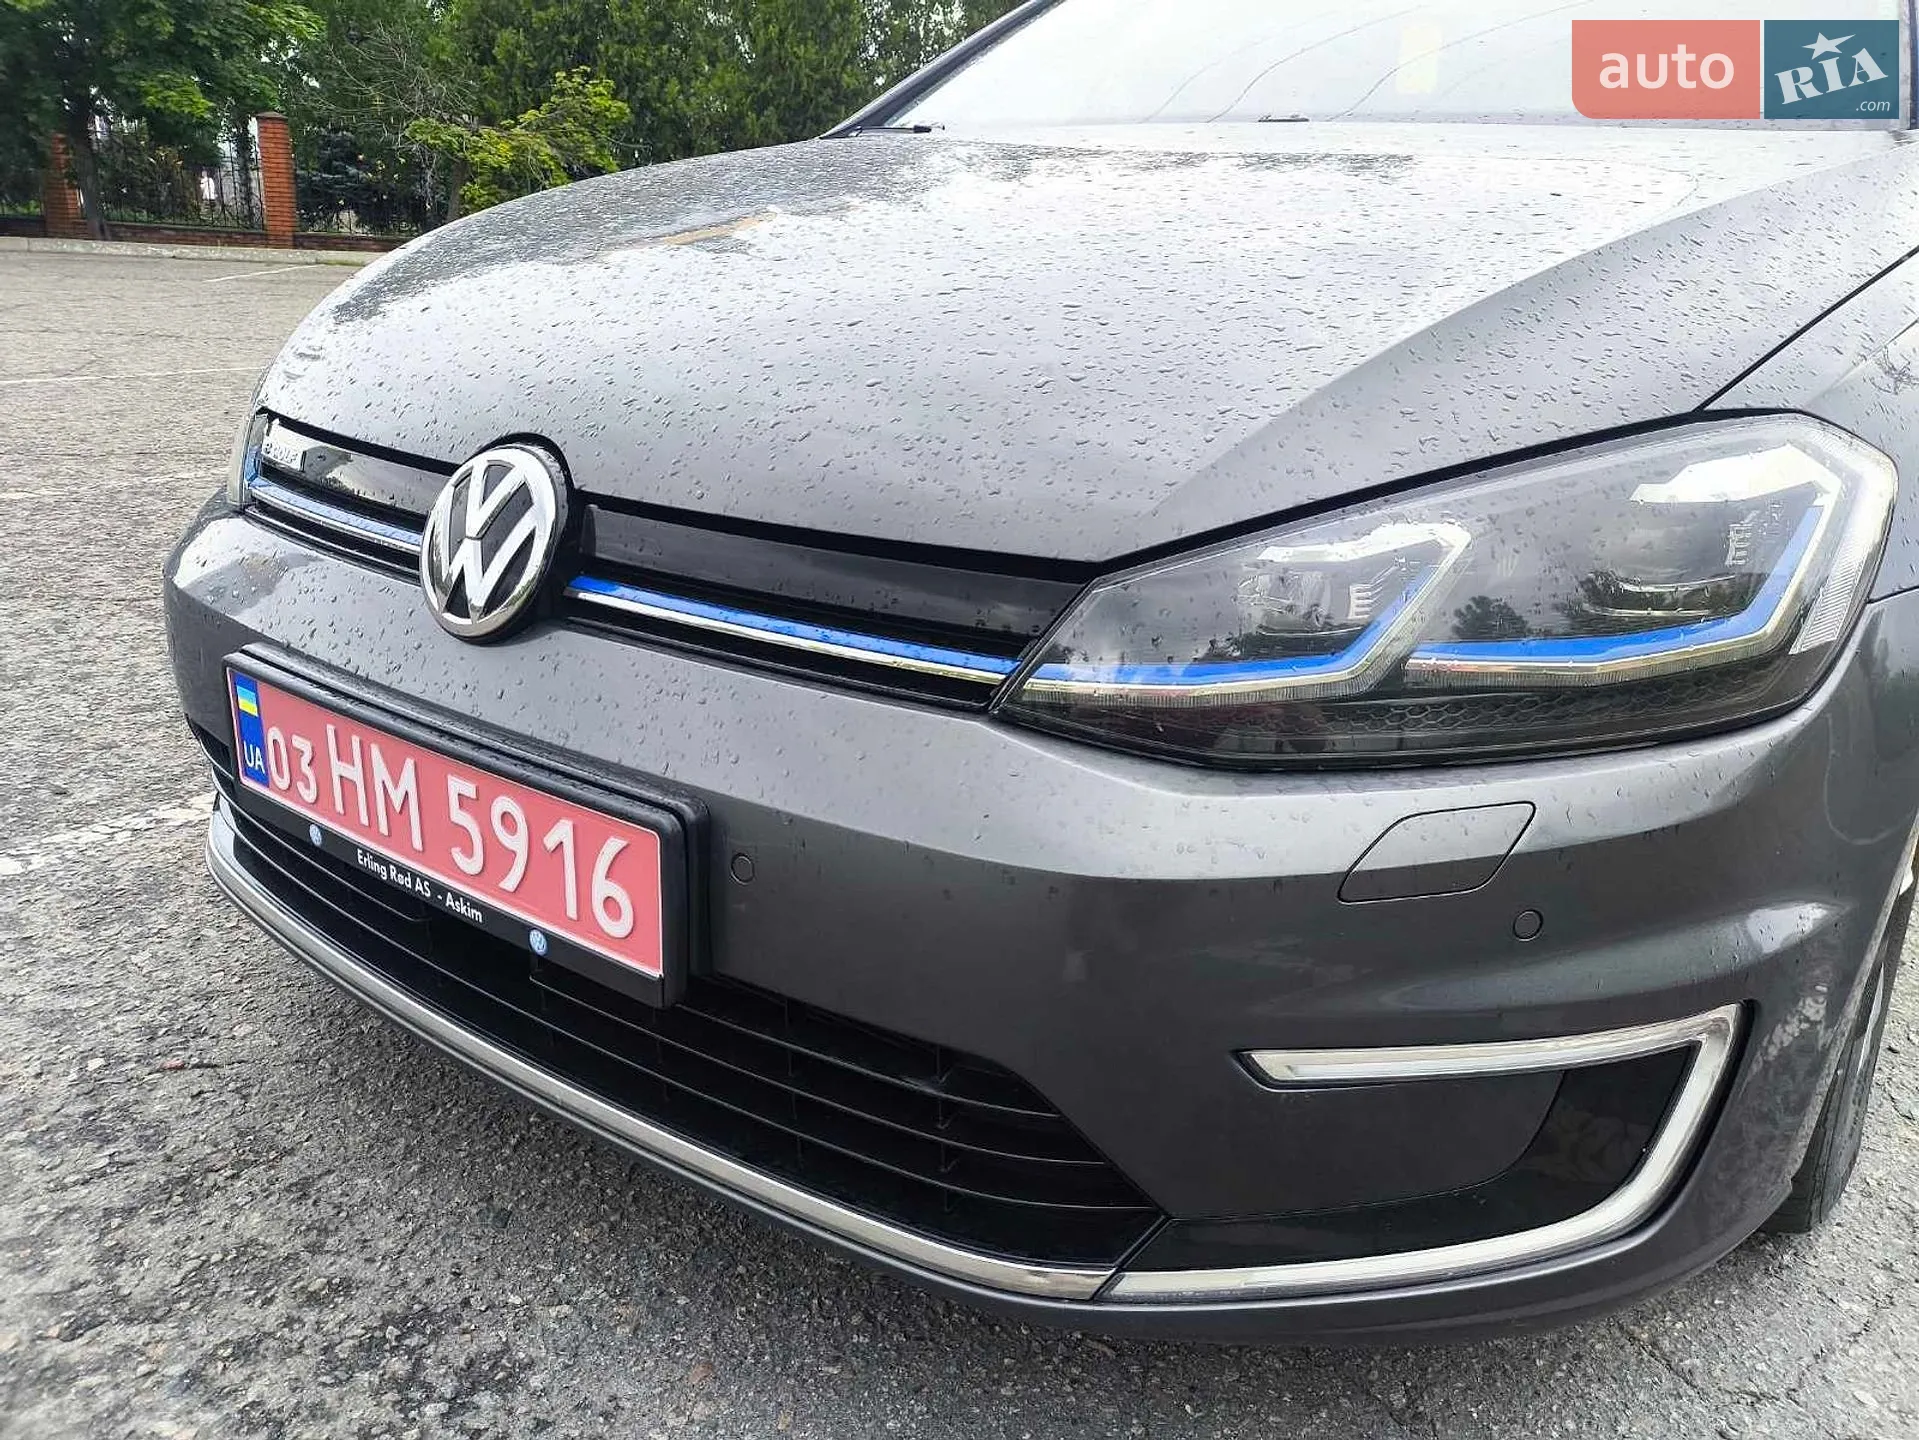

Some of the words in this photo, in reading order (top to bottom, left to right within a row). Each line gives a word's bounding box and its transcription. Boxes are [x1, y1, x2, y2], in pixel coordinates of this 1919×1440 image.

[244, 740, 265, 774] UA
[267, 726, 318, 803] 03
[326, 724, 423, 852] HM
[447, 774, 634, 938] 5916
[357, 848, 388, 880] Erling
[415, 877, 431, 897] AS
[445, 892, 483, 923] Askim
